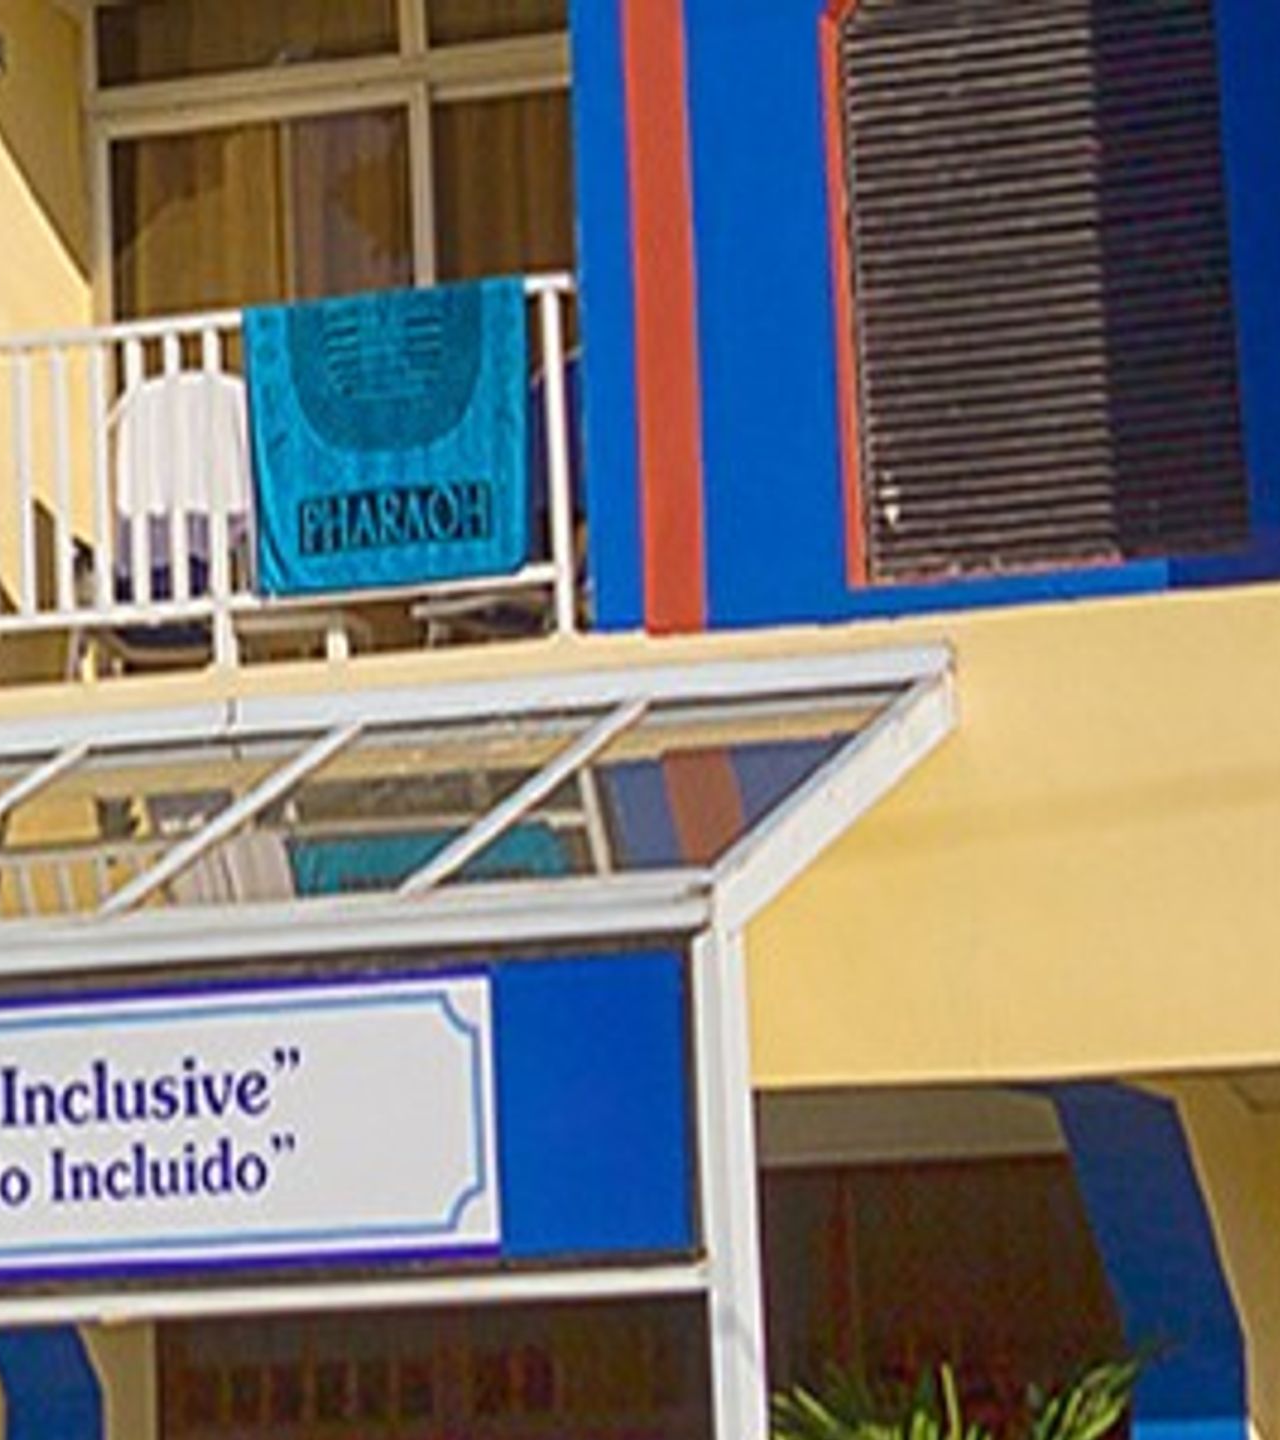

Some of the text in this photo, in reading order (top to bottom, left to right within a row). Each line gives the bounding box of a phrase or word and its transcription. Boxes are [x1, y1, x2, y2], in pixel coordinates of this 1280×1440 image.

[300, 479, 492, 557] PHARAOH
[0, 1047, 302, 1129] Inclusive”
[50, 1134, 297, 1202] Incluido”
